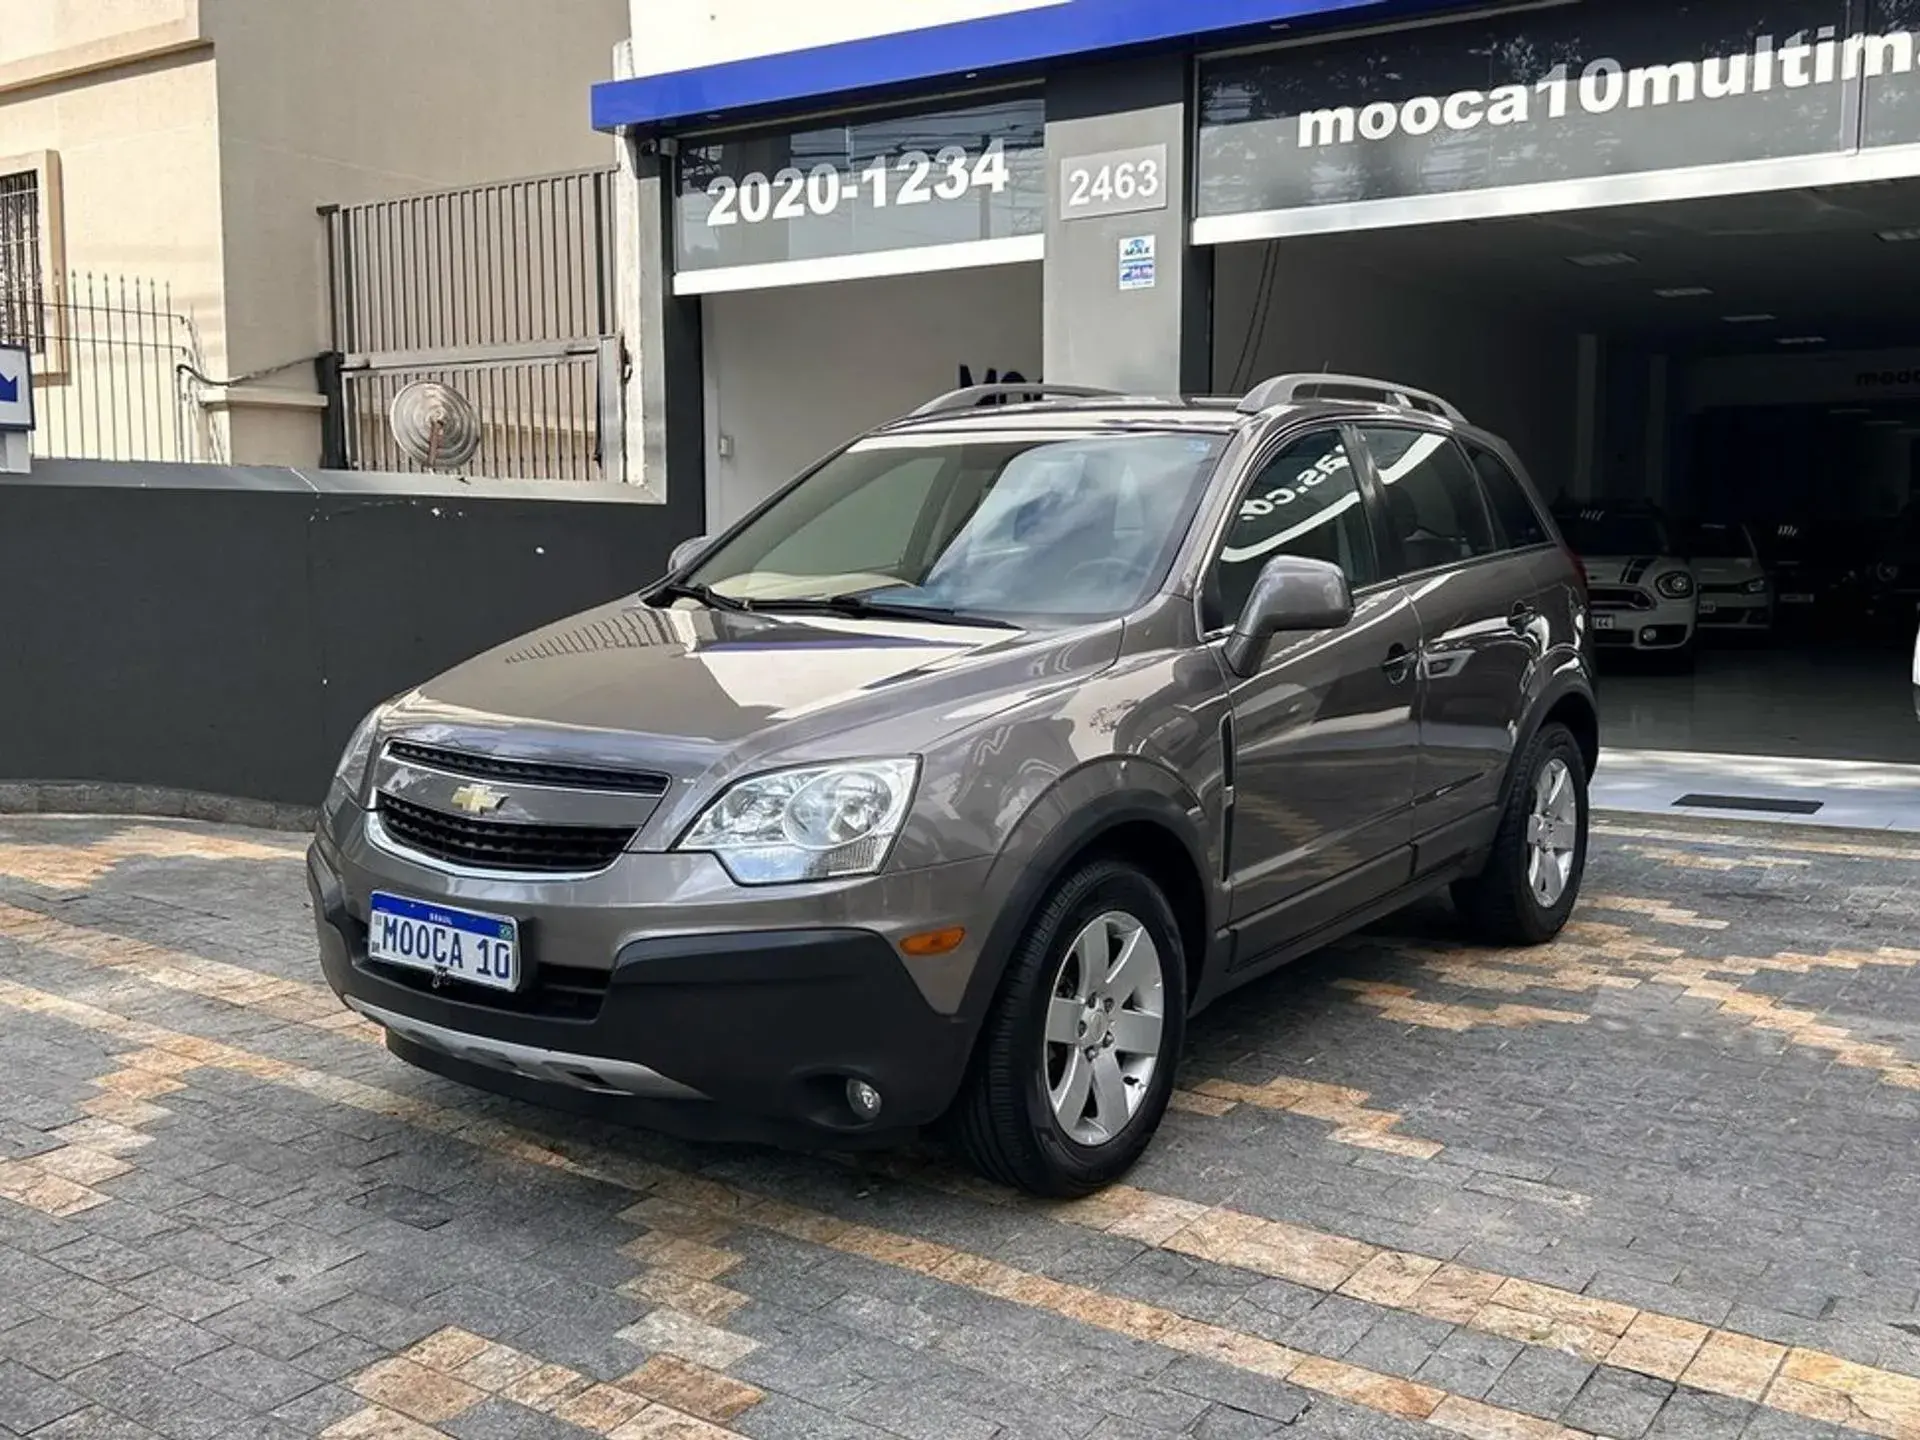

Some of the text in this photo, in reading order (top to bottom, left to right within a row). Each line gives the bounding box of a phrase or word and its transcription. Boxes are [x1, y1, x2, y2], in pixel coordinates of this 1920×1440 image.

[1297, 25, 1920, 148] mooca10multim
[705, 138, 1010, 227] 2020-1234
[1068, 158, 1159, 207] 2463
[382, 915, 510, 980] MOOCA 10
